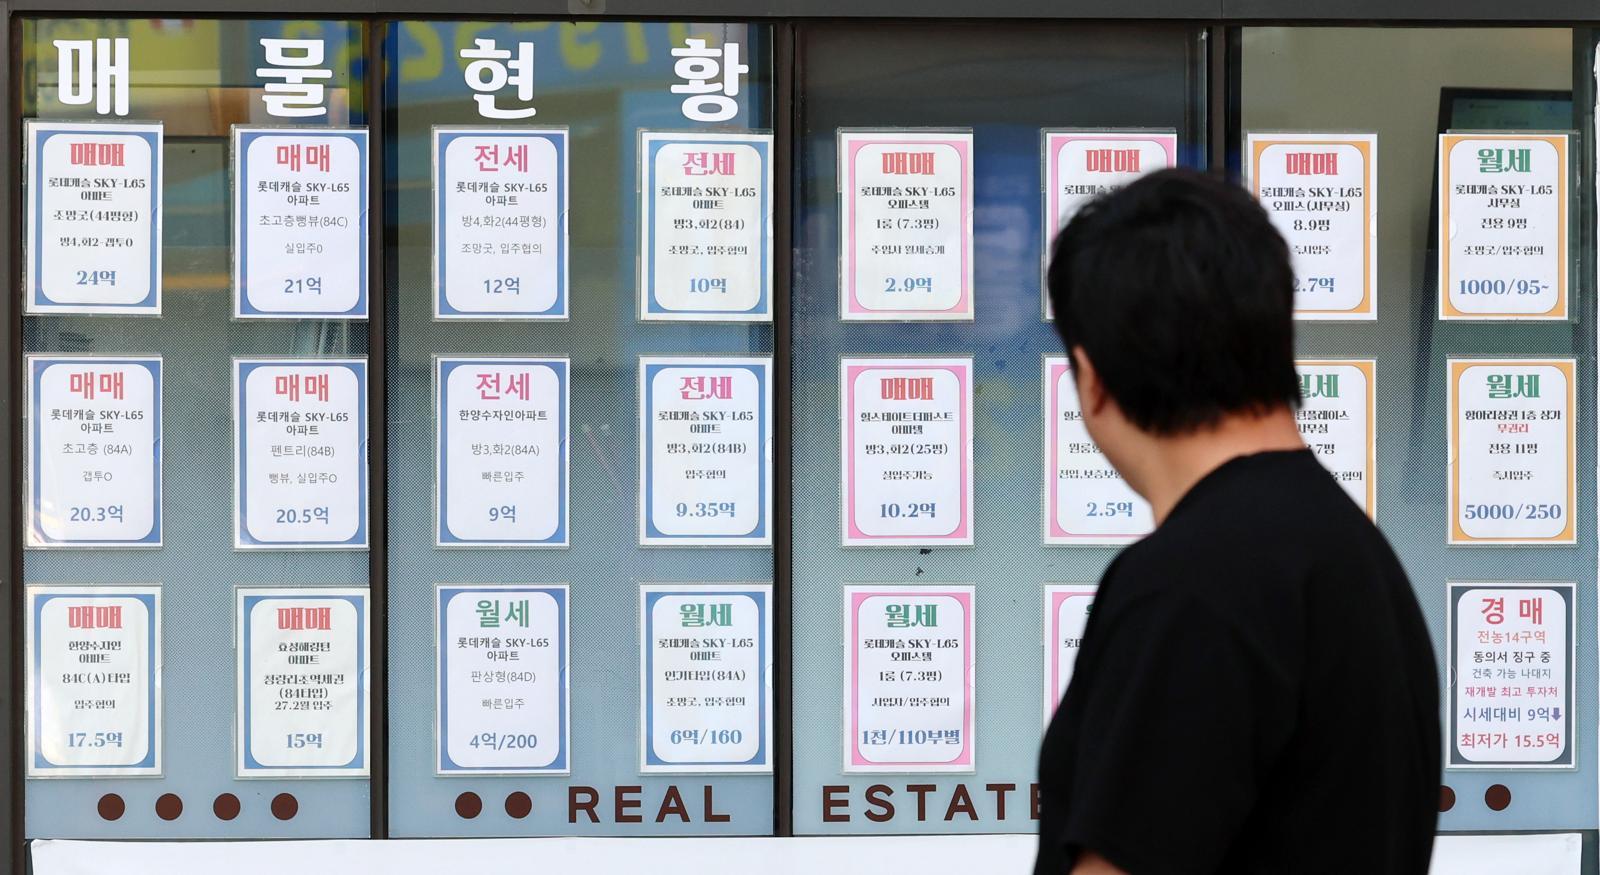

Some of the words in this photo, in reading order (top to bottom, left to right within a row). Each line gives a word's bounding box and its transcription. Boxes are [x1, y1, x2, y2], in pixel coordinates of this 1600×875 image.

[69, 142, 126, 167] 매매
[276, 143, 331, 175] 매매
[473, 143, 529, 174] 전세
[1085, 149, 1141, 173] 매매
[1476, 147, 1532, 174] 월세
[681, 151, 736, 176] 전세
[880, 151, 936, 176] 매매
[1286, 152, 1338, 175] 매매
[48, 176, 91, 188] 롯데캐슬
[93, 177, 146, 189] SKY-L65
[257, 180, 303, 193] 롯데캐슬
[305, 182, 350, 193] SKY-L65
[455, 181, 501, 194] 롯데캐슬
[503, 182, 548, 193] SKY-L65
[80, 190, 113, 201] 아파트
[660, 186, 703, 197] 롯데캐슬
[705, 186, 757, 198] SKY-L65
[860, 184, 903, 197] 롯데캐슬
[904, 186, 956, 197] SKY-L65
[1064, 184, 1107, 195] 롯데캐슬
[1261, 187, 1306, 198] 롯데캐슬
[1308, 187, 1362, 198] SKY-L65
[1455, 183, 1499, 195] 롯데캐슬
[1500, 184, 1553, 196] SKY-L65
[286, 194, 321, 207] 아파트
[485, 194, 519, 207] 아파트
[692, 199, 725, 210] 아파트
[887, 198, 930, 210] 오피스텔
[1272, 200, 1350, 212] 오피스(사무실)
[1487, 197, 1521, 209] 사무실
[461, 215, 547, 229] 방4,화2(44평형)
[673, 218, 745, 231] 방3,화2(84)
[896, 217, 940, 230] (7.3평)
[1293, 219, 1330, 231] 8.9평
[1481, 217, 1505, 230] 전용
[1507, 217, 1528, 230] 9평
[500, 242, 542, 255] 입주협의
[706, 245, 748, 256] 입주협의
[1463, 244, 1544, 256] 조망굿/입주협의
[76, 270, 117, 287] 24억
[884, 277, 933, 293] 2.9억
[284, 276, 322, 296] 21억
[483, 276, 520, 296] 12억
[689, 277, 727, 294] 10억
[69, 371, 124, 401] 매매
[274, 373, 329, 403] 매매
[476, 372, 530, 401] 전세
[679, 375, 734, 401] 전세
[879, 376, 935, 401] 매매
[1485, 373, 1541, 400] 월세
[50, 408, 96, 421] 롯데캐슬
[99, 409, 144, 421] SKY-L65
[255, 410, 301, 423] 롯데캐슬
[304, 411, 349, 423] SKY-L65
[458, 408, 548, 422] 한양수자인아파트
[657, 410, 700, 422] 롯데캐슬
[702, 410, 754, 422] SKY-L65
[860, 411, 953, 423] 힐스테이트더퍼스트
[1464, 409, 1519, 421] 항아리상권
[1521, 409, 1538, 421] 1층
[1540, 409, 1562, 421] 상가
[80, 422, 115, 435] 아파트
[286, 424, 320, 437] 아파트
[689, 423, 721, 434] 아파트
[891, 424, 924, 435] 아파텔
[1497, 423, 1529, 434] 무권리
[62, 442, 99, 456] 초고층
[103, 443, 133, 457] (84A)
[271, 444, 335, 458] 펜트리(84B)
[471, 443, 540, 457] 방3,화2(84A)
[666, 442, 747, 455] 방3,화2(84B)
[865, 442, 948, 456] 방3,화2(25평)
[1488, 442, 1513, 455] 전용
[1515, 442, 1538, 455] 11평
[481, 471, 525, 483] 빠른입주
[684, 469, 727, 480] 입주협의
[882, 470, 934, 481] 실입주가능
[1492, 470, 1534, 481] 즉시입주
[69, 504, 124, 524] 20.3억
[275, 506, 329, 525] 20.5억
[488, 504, 516, 524] 9억
[675, 502, 736, 518] 9.35억
[880, 502, 937, 519] 10.2억
[1086, 502, 1133, 518] 2.5억
[1464, 503, 1562, 520] 5000/250
[66, 605, 123, 630] 매매
[276, 606, 332, 631] 매매
[475, 599, 530, 629] 월세
[679, 602, 734, 628] 월세
[884, 603, 939, 629] 월세
[456, 636, 502, 649] 롯데캐슬
[505, 637, 550, 648] SKY-L65
[658, 637, 701, 649] 롯데캐슬
[702, 637, 754, 649] SKY-L65
[863, 638, 906, 649] 롯데캐슬
[907, 638, 959, 649] SKY-L65
[1477, 630, 1546, 645] 전농14구역
[68, 640, 122, 652] 한양수자인
[278, 641, 331, 653] 효성해링턴
[78, 653, 111, 664] 아파트
[287, 654, 320, 665] 아파트
[486, 649, 520, 662] 아파트
[689, 650, 721, 662] 아파트
[890, 651, 933, 662] 오피스텔
[1472, 650, 1508, 664] 동의서
[1512, 650, 1537, 664] 징구
[1539, 650, 1551, 664] 중
[471, 670, 536, 684] 판상형(84D)
[664, 669, 746, 682] 인기타입(84A)
[899, 669, 943, 683] (7.3평)
[1472, 667, 1493, 680] 건축
[1496, 667, 1517, 680] 가능
[1521, 668, 1551, 680] 나대지
[279, 686, 329, 700] (84타입)
[1464, 685, 1497, 698] 재개발
[1500, 686, 1522, 698] 최고
[1526, 686, 1558, 698] 투자처
[73, 699, 116, 710] 입주협의
[312, 700, 333, 711] 입주
[481, 698, 525, 710] 빠른입주
[704, 696, 746, 707] 입주협의
[871, 696, 950, 708] 사업자/입주협의
[1463, 706, 1521, 723] 시세대비
[1527, 706, 1550, 723] 9억
[67, 731, 123, 748] 17.5억
[286, 732, 323, 749] 15억
[469, 731, 538, 752] 4억/200
[670, 728, 743, 745] 6억/160
[1460, 732, 1509, 750] 최저가
[1514, 732, 1560, 749] 15.5억
[568, 785, 731, 823] REAL
